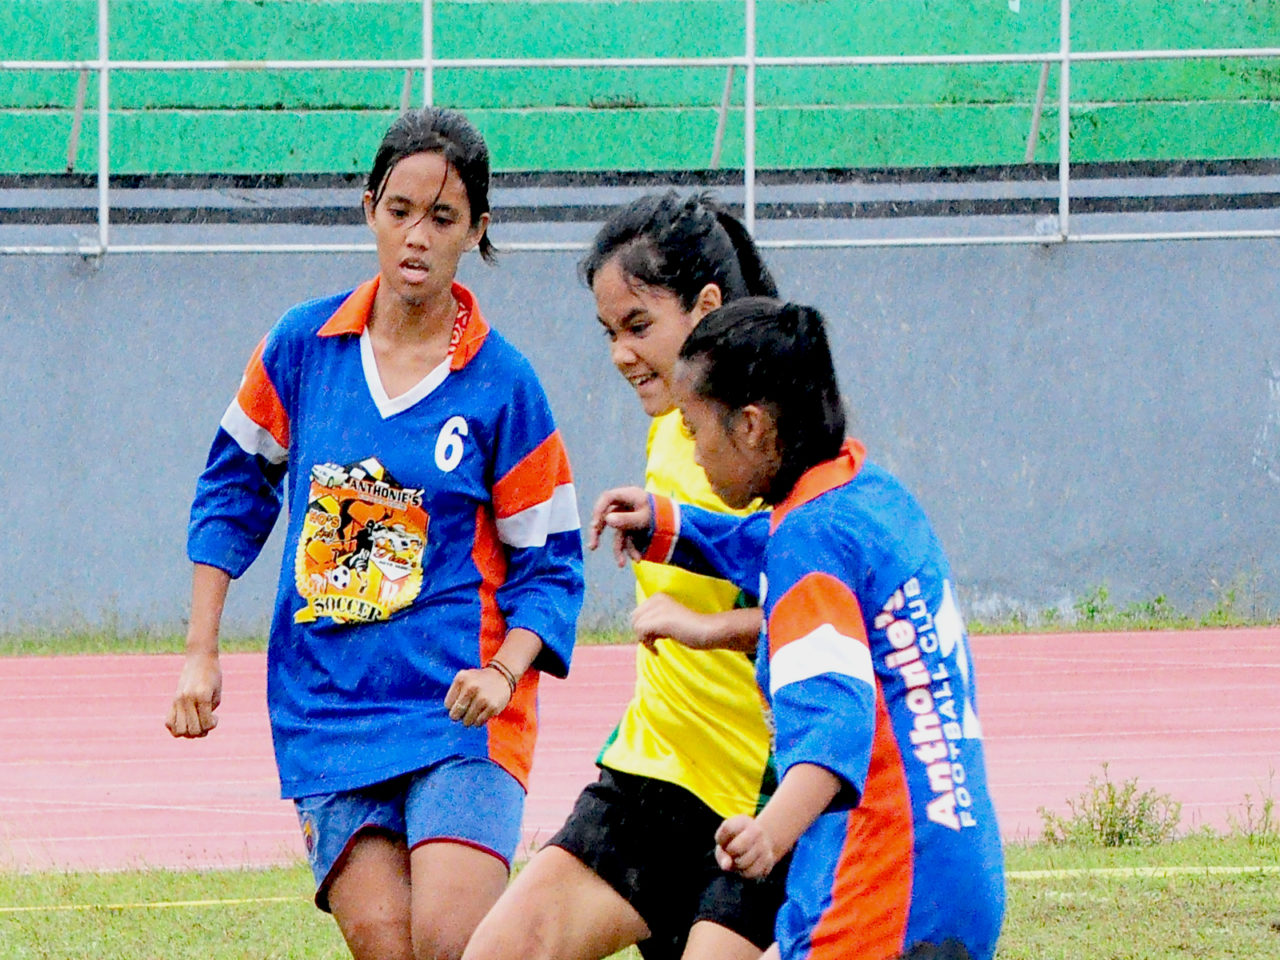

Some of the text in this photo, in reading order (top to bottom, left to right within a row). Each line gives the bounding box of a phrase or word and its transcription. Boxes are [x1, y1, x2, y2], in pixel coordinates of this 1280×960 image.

[434, 416, 469, 473] 6
[349, 478, 422, 507] ANTHONIE'S
[903, 577, 939, 655] CLUB
[929, 662, 977, 828] FOOTBALL
